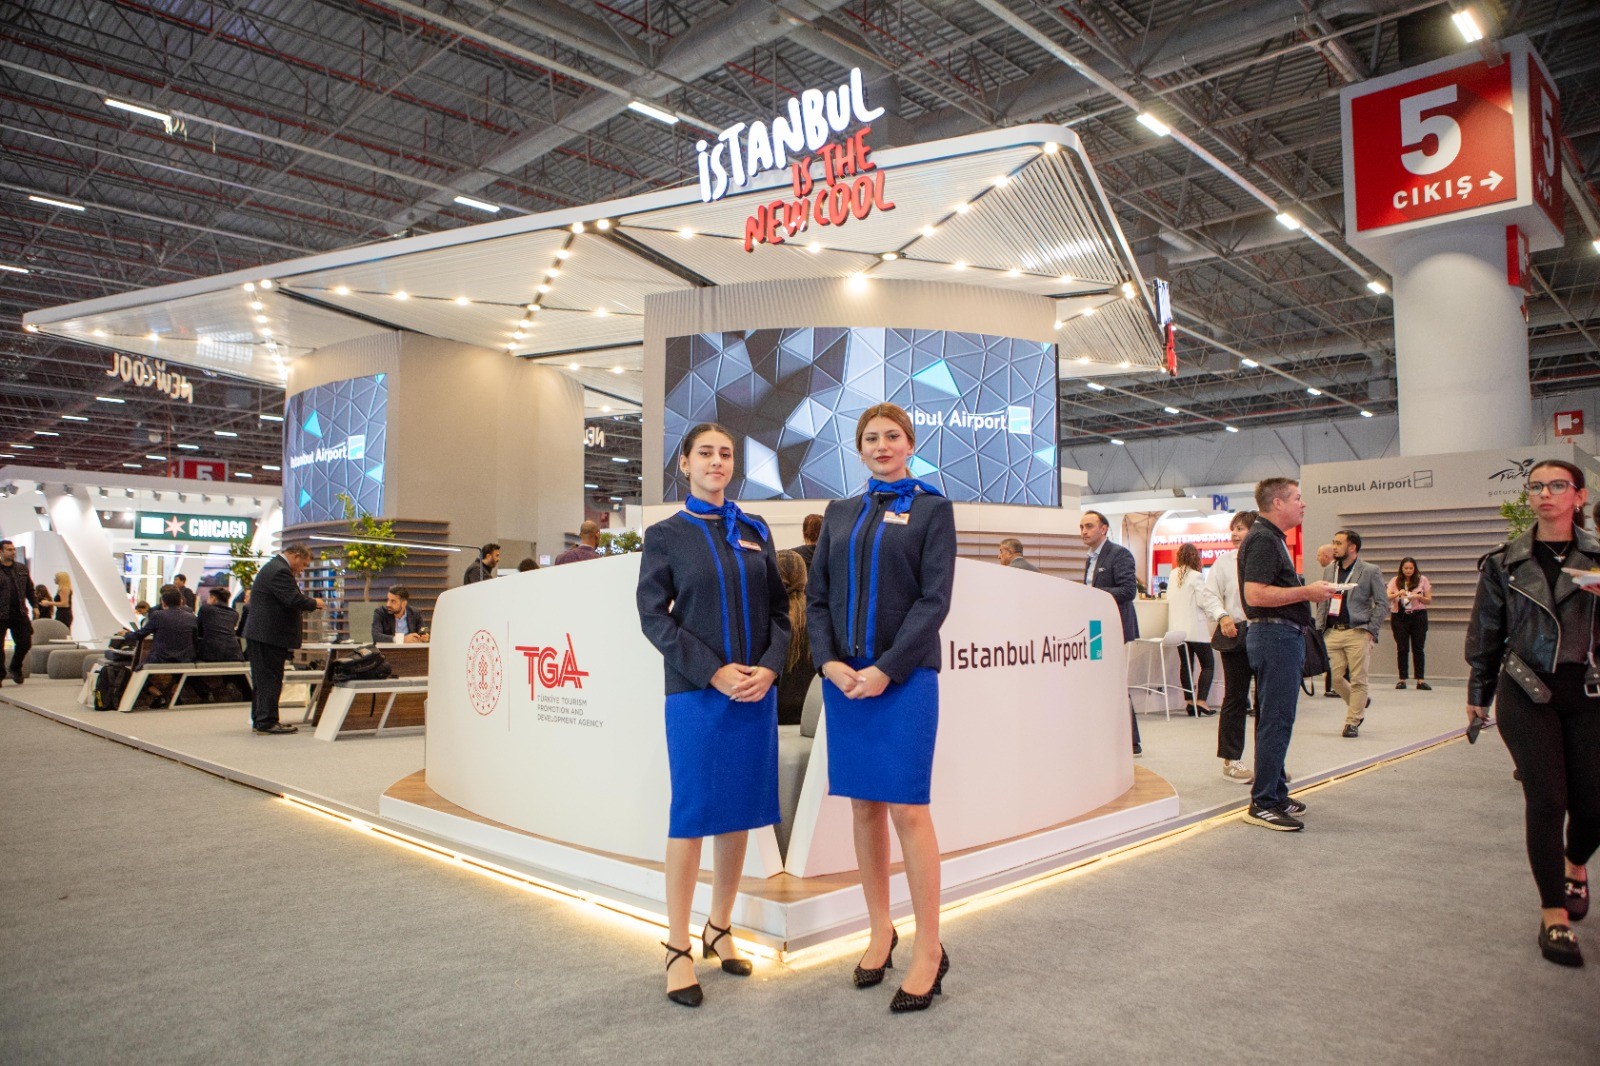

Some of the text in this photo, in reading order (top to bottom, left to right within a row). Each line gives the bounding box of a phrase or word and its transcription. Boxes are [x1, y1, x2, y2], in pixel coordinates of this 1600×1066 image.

[1400, 84, 1462, 175] 5
[1541, 85, 1555, 177] 5
[792, 127, 877, 197] IS THE
[743, 170, 896, 252] NEW COOL
[949, 410, 1007, 431] Airport
[315, 445, 347, 463] Airport
[1317, 478, 1412, 495] Istanbul Airport
[1488, 488, 1524, 498] goturki
[188, 518, 248, 539] CHICAGO
[1168, 532, 1232, 545] INTERNATIONA
[950, 635, 1088, 670] Istanbul Airport
[515, 632, 590, 701] TGA
[537, 705, 584, 717] PROMOTION AND
[561, 697, 588, 707] TOURISM
[537, 713, 604, 729] DEVELOPMENT AGENCY
